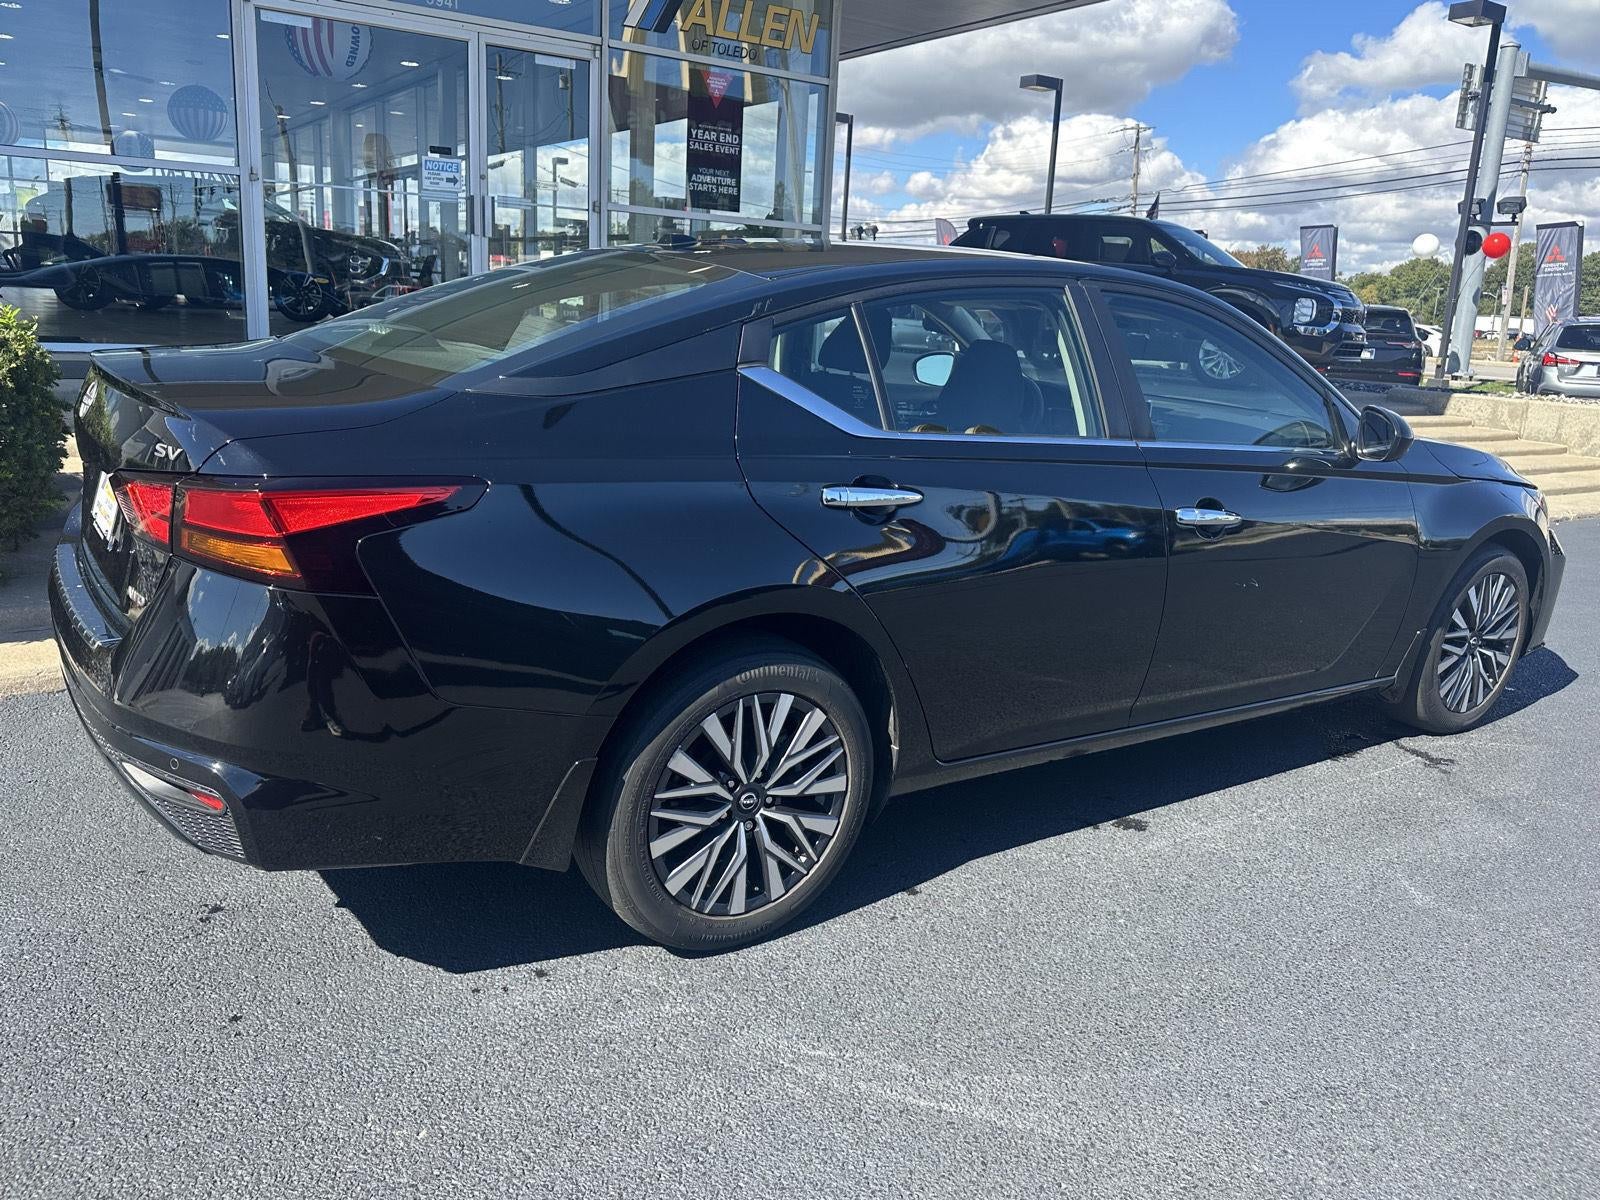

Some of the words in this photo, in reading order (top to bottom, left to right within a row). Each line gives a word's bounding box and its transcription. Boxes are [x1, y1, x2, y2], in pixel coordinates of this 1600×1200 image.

[680, 0, 820, 54] ALLEN
[345, 26, 360, 67] OWNED
[691, 39, 709, 51] OF
[711, 41, 758, 61] TOLEDO
[690, 128, 718, 141] YEAR
[719, 132, 740, 145] END
[689, 141, 714, 152] SALES
[715, 145, 740, 155] EVENT
[426, 160, 459, 172] NOTICE
[698, 167, 714, 175] YOUR
[715, 169, 730, 177] NEXT
[689, 182, 717, 193] STARTS
[718, 186, 739, 196] HERE
[691, 174, 737, 187] ADVENTURE
[154, 442, 183, 460] SV
[735, 664, 812, 685] Continental
